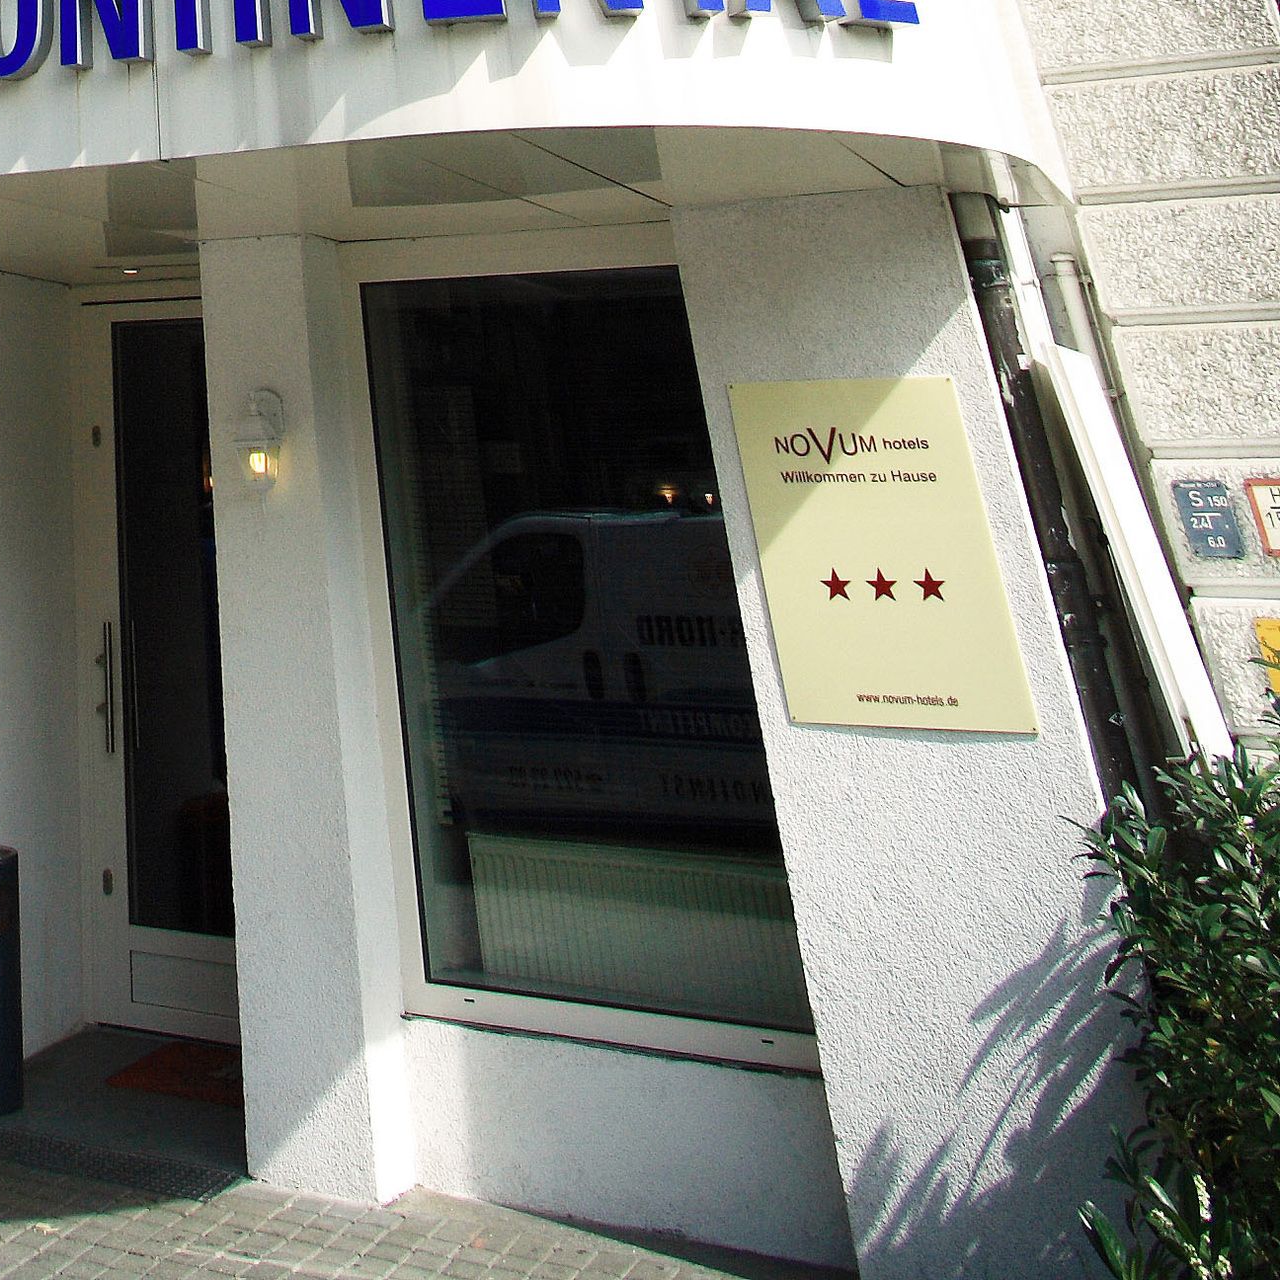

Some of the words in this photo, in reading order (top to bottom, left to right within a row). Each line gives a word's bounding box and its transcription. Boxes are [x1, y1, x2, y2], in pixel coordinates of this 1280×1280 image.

[882, 437, 930, 451] hotels
[780, 470, 867, 485] Willkommen
[870, 473, 888, 483] zu
[891, 470, 938, 484] Hause
[1188, 490, 1204, 508] S
[856, 692, 960, 708] www.novum-hotels.de
